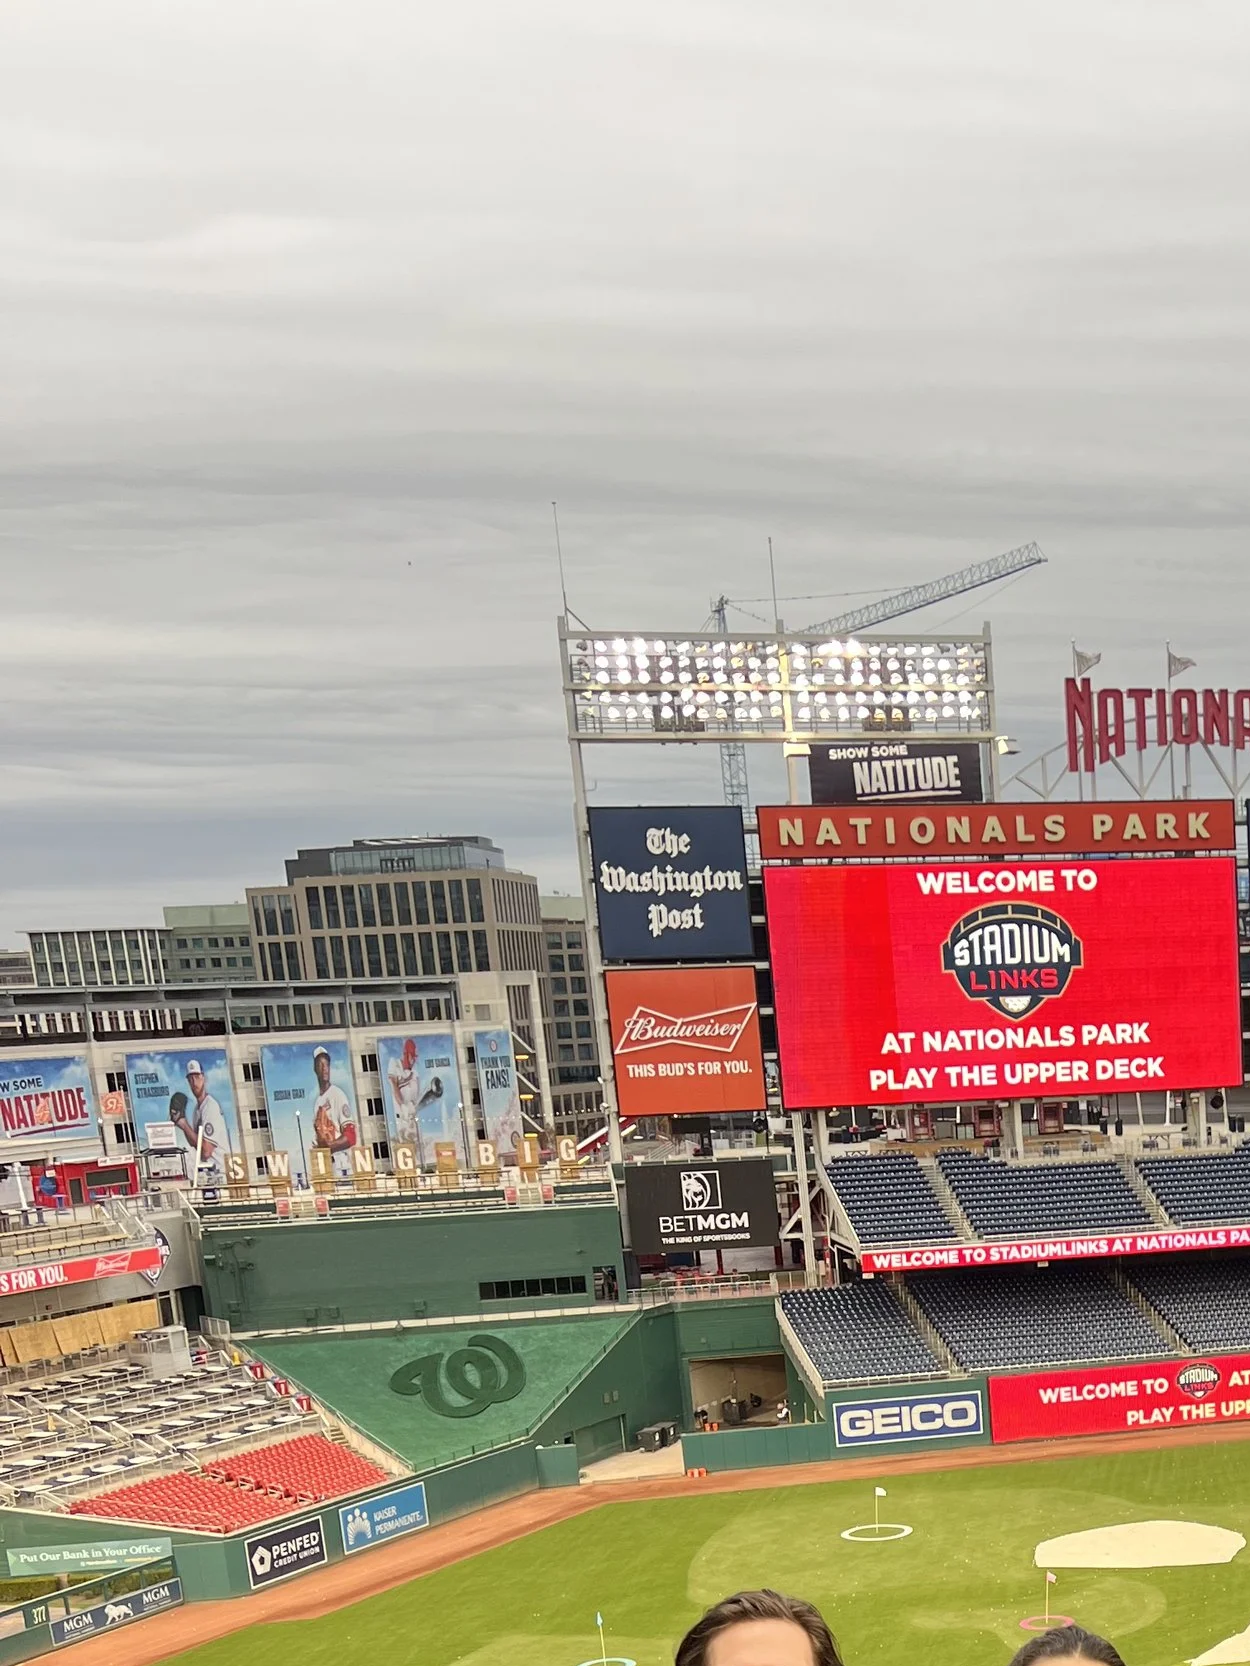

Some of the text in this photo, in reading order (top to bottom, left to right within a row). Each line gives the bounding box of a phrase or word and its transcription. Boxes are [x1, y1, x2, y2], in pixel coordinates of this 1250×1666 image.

[828, 744, 908, 760] SHOW SOME
[853, 755, 961, 795] NATITUDE
[779, 812, 1211, 847] NATIONALS PARK
[645, 827, 692, 858] The
[600, 860, 744, 898] Washington
[916, 869, 1098, 895] WELCOME TO
[648, 902, 704, 938] Post
[954, 923, 1071, 966] STADIUM
[970, 969, 1058, 991] LINKS
[625, 1017, 742, 1041] Budweiser
[880, 1022, 1150, 1055] AT NATIONALS PARK
[485, 1069, 510, 1089] FANS!
[626, 1060, 753, 1078] THIS BUD'S FOR YOU.
[869, 1056, 1165, 1091] PLAY THE UPPER DECK
[13, 1077, 42, 1091] SOME
[659, 1212, 750, 1233] BETMGM
[676, 1236, 692, 1244] KING
[703, 1233, 750, 1242] SPORTSBOOKS
[872, 1252, 959, 1269] WELCOME
[962, 1249, 986, 1264] TO
[989, 1240, 1109, 1262] STADIUMLINKS
[1111, 1237, 1133, 1252] AT
[1135, 1232, 1226, 1251] NATIONALS
[11, 1271, 38, 1290] FOR
[38, 1265, 68, 1287] YOU.
[1142, 1378, 1168, 1395] TO
[1179, 1366, 1220, 1385] STADIUM
[1039, 1384, 1138, 1404] WELCOME
[1184, 1382, 1215, 1392] LINKS
[840, 1400, 977, 1438] GEICO
[1127, 1406, 1175, 1426] PLAY
[1178, 1403, 1216, 1420] THE
[373, 1505, 397, 1522] KAISER
[19, 1544, 161, 1564] Put Our Bank in Your Office
[272, 1532, 319, 1559] PENFED
[274, 1546, 320, 1568] CREDIT UNION
[142, 1586, 170, 1605] MGM
[31, 1605, 46, 1624] 377
[63, 1612, 93, 1633] MGM
